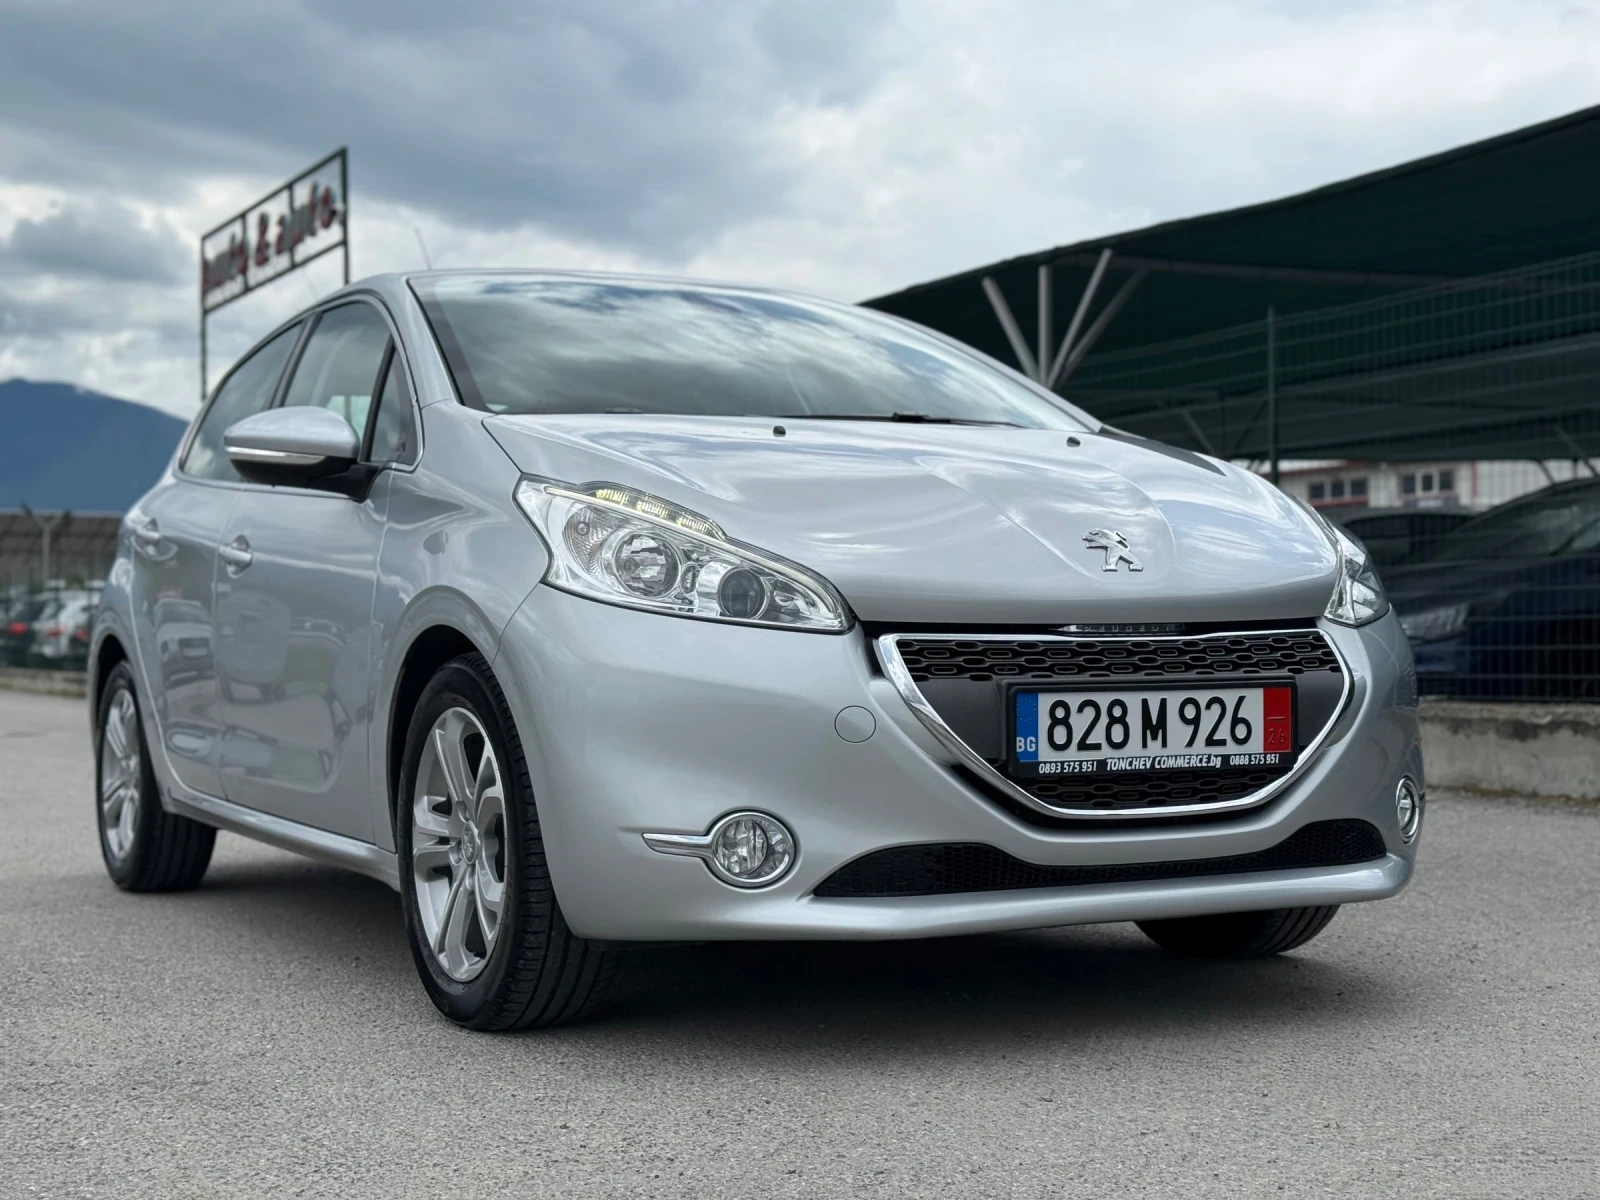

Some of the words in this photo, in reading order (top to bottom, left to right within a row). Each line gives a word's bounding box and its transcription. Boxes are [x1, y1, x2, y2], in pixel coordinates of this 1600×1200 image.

[1047, 698, 1131, 751] 828
[1141, 697, 1168, 749] M
[1178, 695, 1252, 748] 926
[1016, 736, 1036, 753] BG
[1038, 763, 1061, 774] 0893
[1063, 762, 1080, 773] 575
[1081, 761, 1098, 772] 951
[1106, 757, 1153, 771] TONCHEV
[1154, 755, 1222, 769] COMMERCE.bg
[1229, 755, 1249, 766] 0888
[1250, 754, 1265, 765] 575
[1266, 754, 1280, 765] 951
